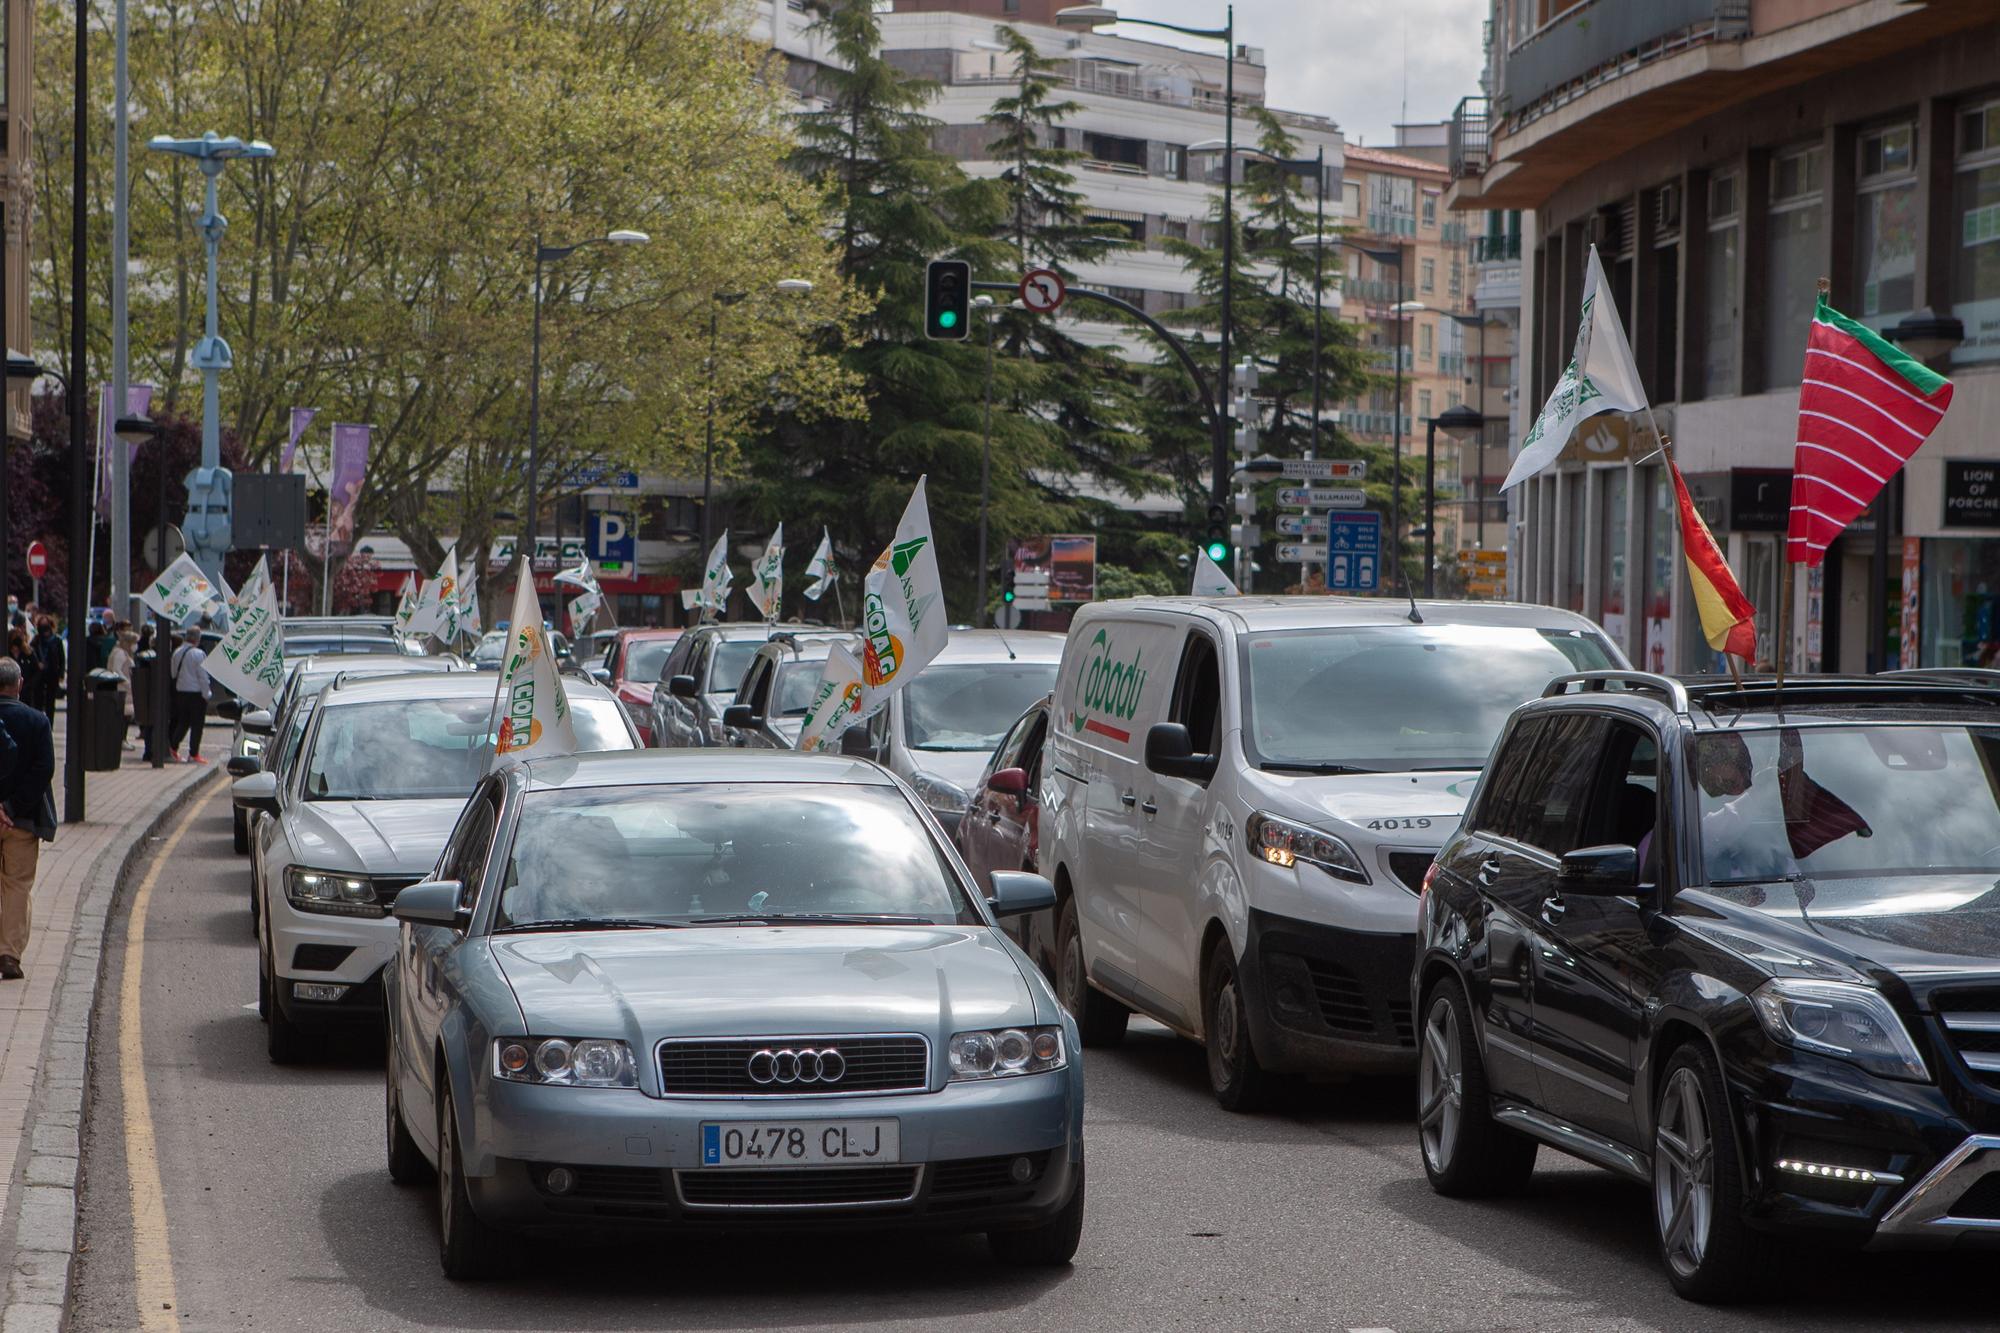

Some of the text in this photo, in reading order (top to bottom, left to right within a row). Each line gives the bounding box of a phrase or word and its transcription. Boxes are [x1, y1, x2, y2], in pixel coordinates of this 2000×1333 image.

[1963, 470, 1994, 481] LION
[1969, 484, 1987, 495] OF
[598, 514, 626, 557] P
[901, 575, 920, 633] ASAJA
[231, 607, 265, 643] ASAJA
[865, 593, 896, 676] COAG
[511, 681, 534, 746] COAG
[1367, 818, 1432, 831] 4019
[708, 1148, 716, 1158] E
[724, 1125, 881, 1160] 0478 CLJ
